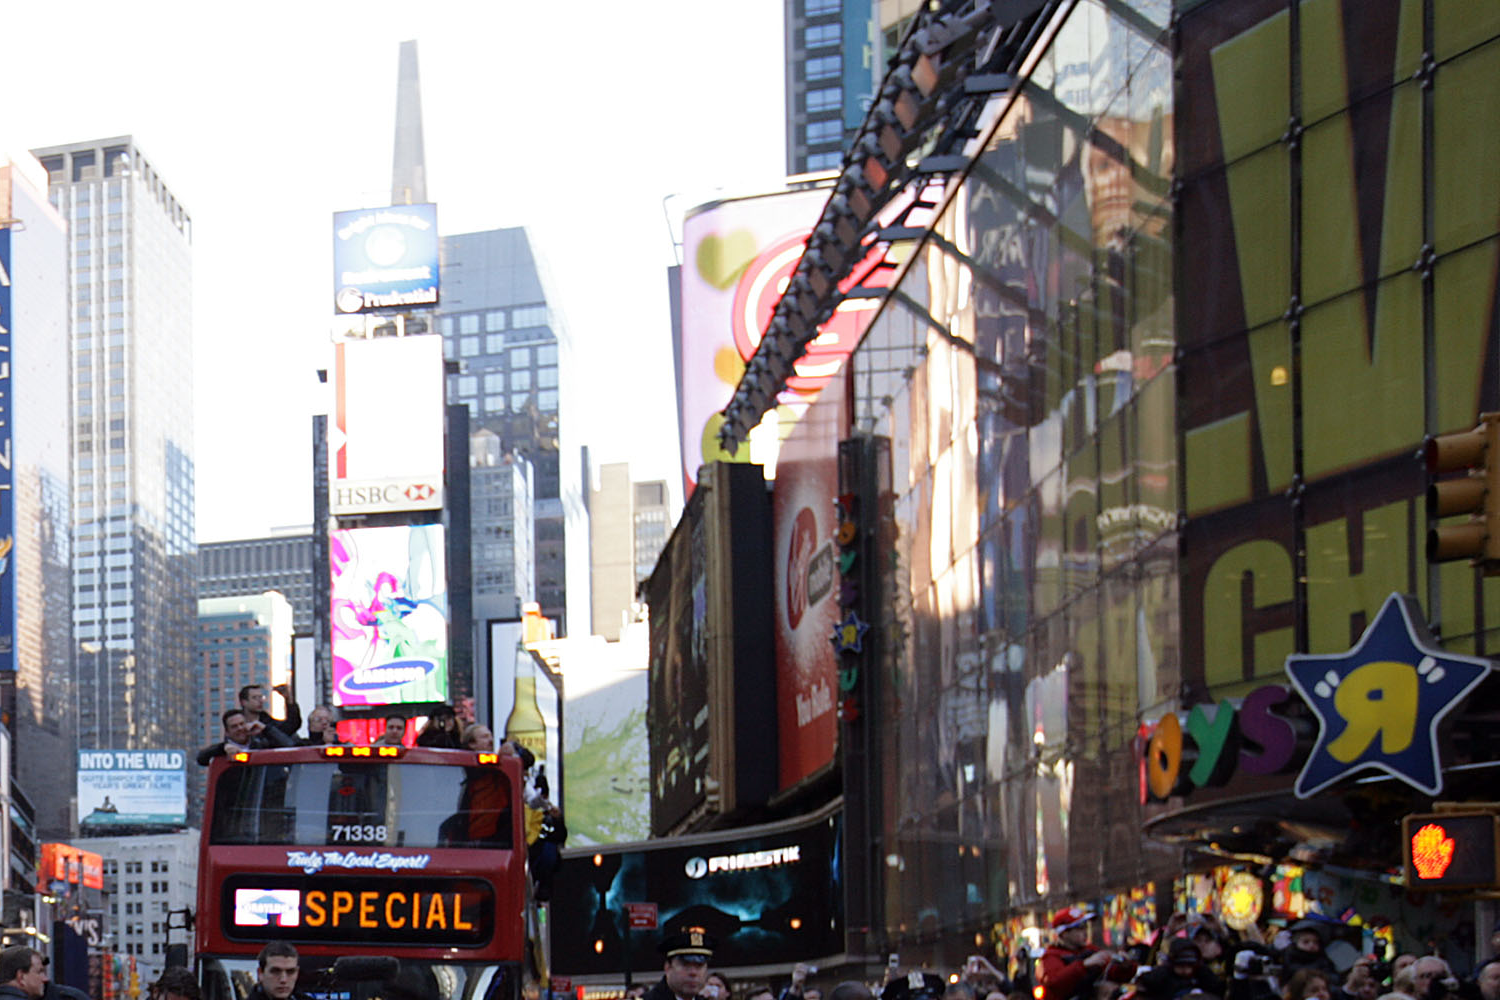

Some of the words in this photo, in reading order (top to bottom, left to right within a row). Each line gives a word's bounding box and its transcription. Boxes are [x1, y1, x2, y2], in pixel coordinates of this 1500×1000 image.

[336, 486, 400, 506] HSBC
[353, 666, 427, 684] SAMSUNG
[80, 753, 113, 769] INTO
[115, 753, 144, 769] THE
[146, 753, 183, 769] WILD
[332, 825, 388, 842] 71338
[304, 890, 473, 931] SPECIAL
